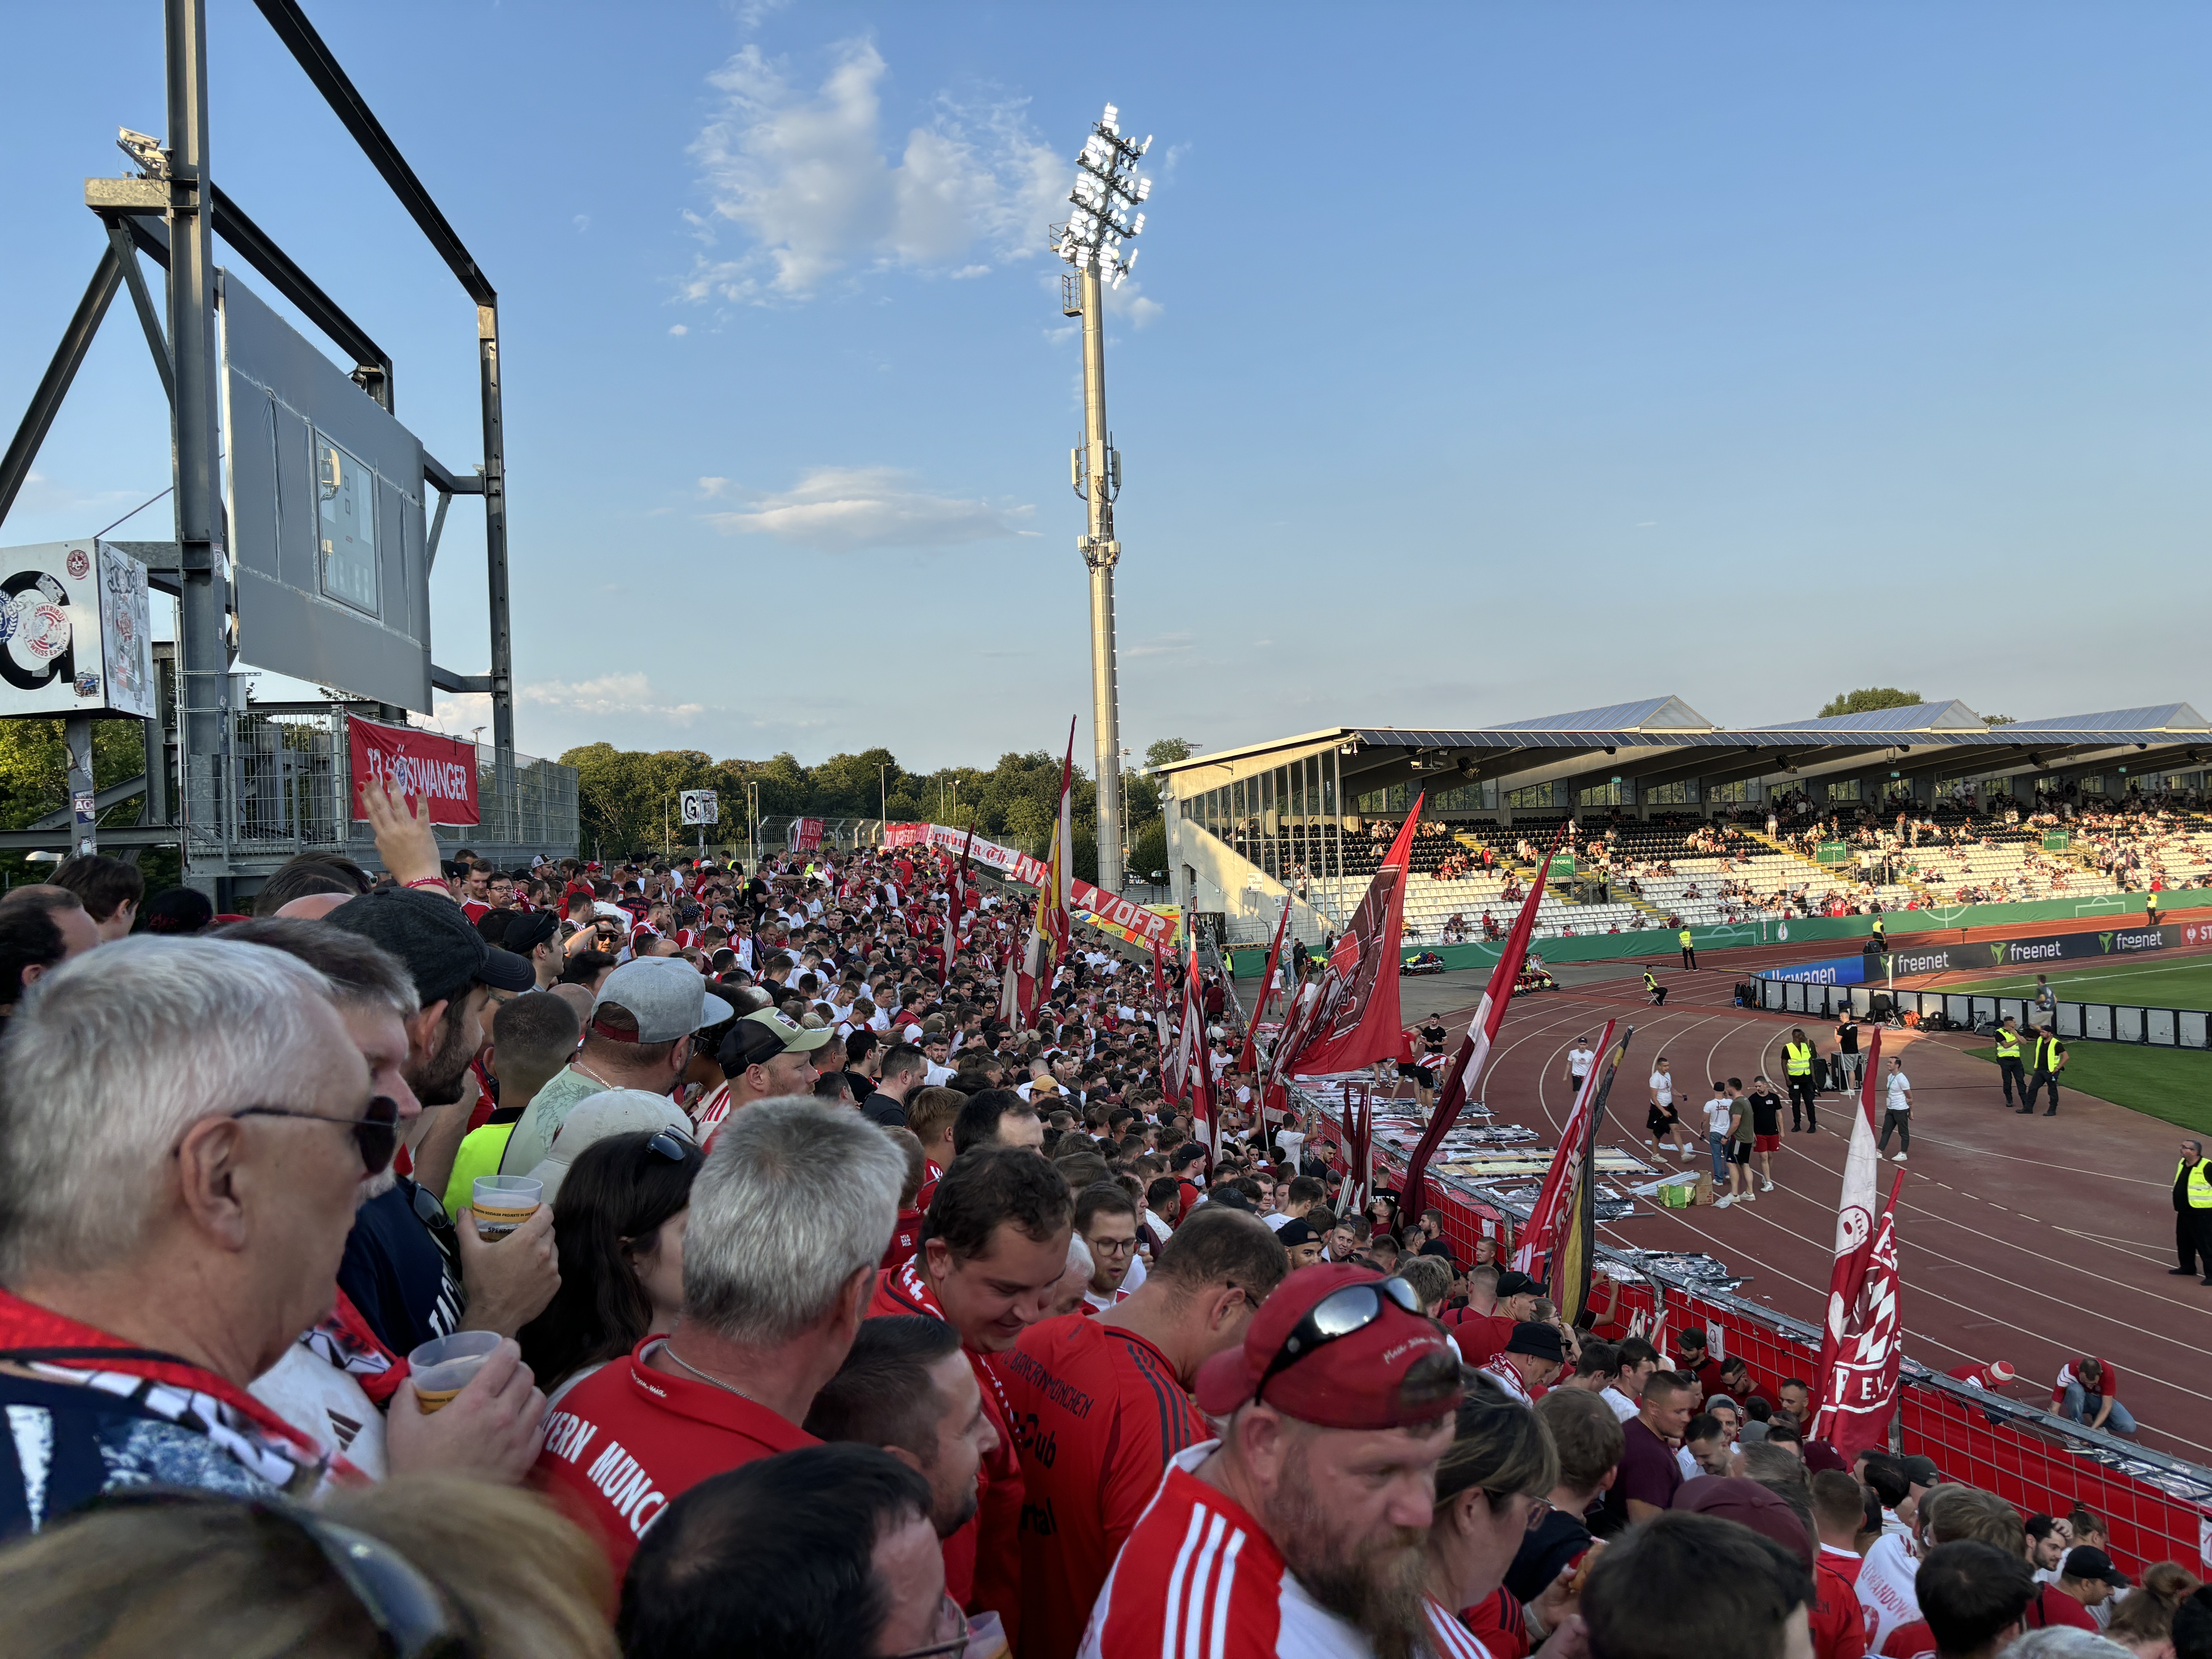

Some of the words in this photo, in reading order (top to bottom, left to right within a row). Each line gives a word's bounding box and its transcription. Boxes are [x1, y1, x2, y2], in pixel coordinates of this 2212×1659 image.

[2011, 941, 2061, 960] freenet
[2116, 931, 2162, 950] freenet
[1898, 951, 1949, 973] freenet
[543, 1412, 598, 1464] YERN
